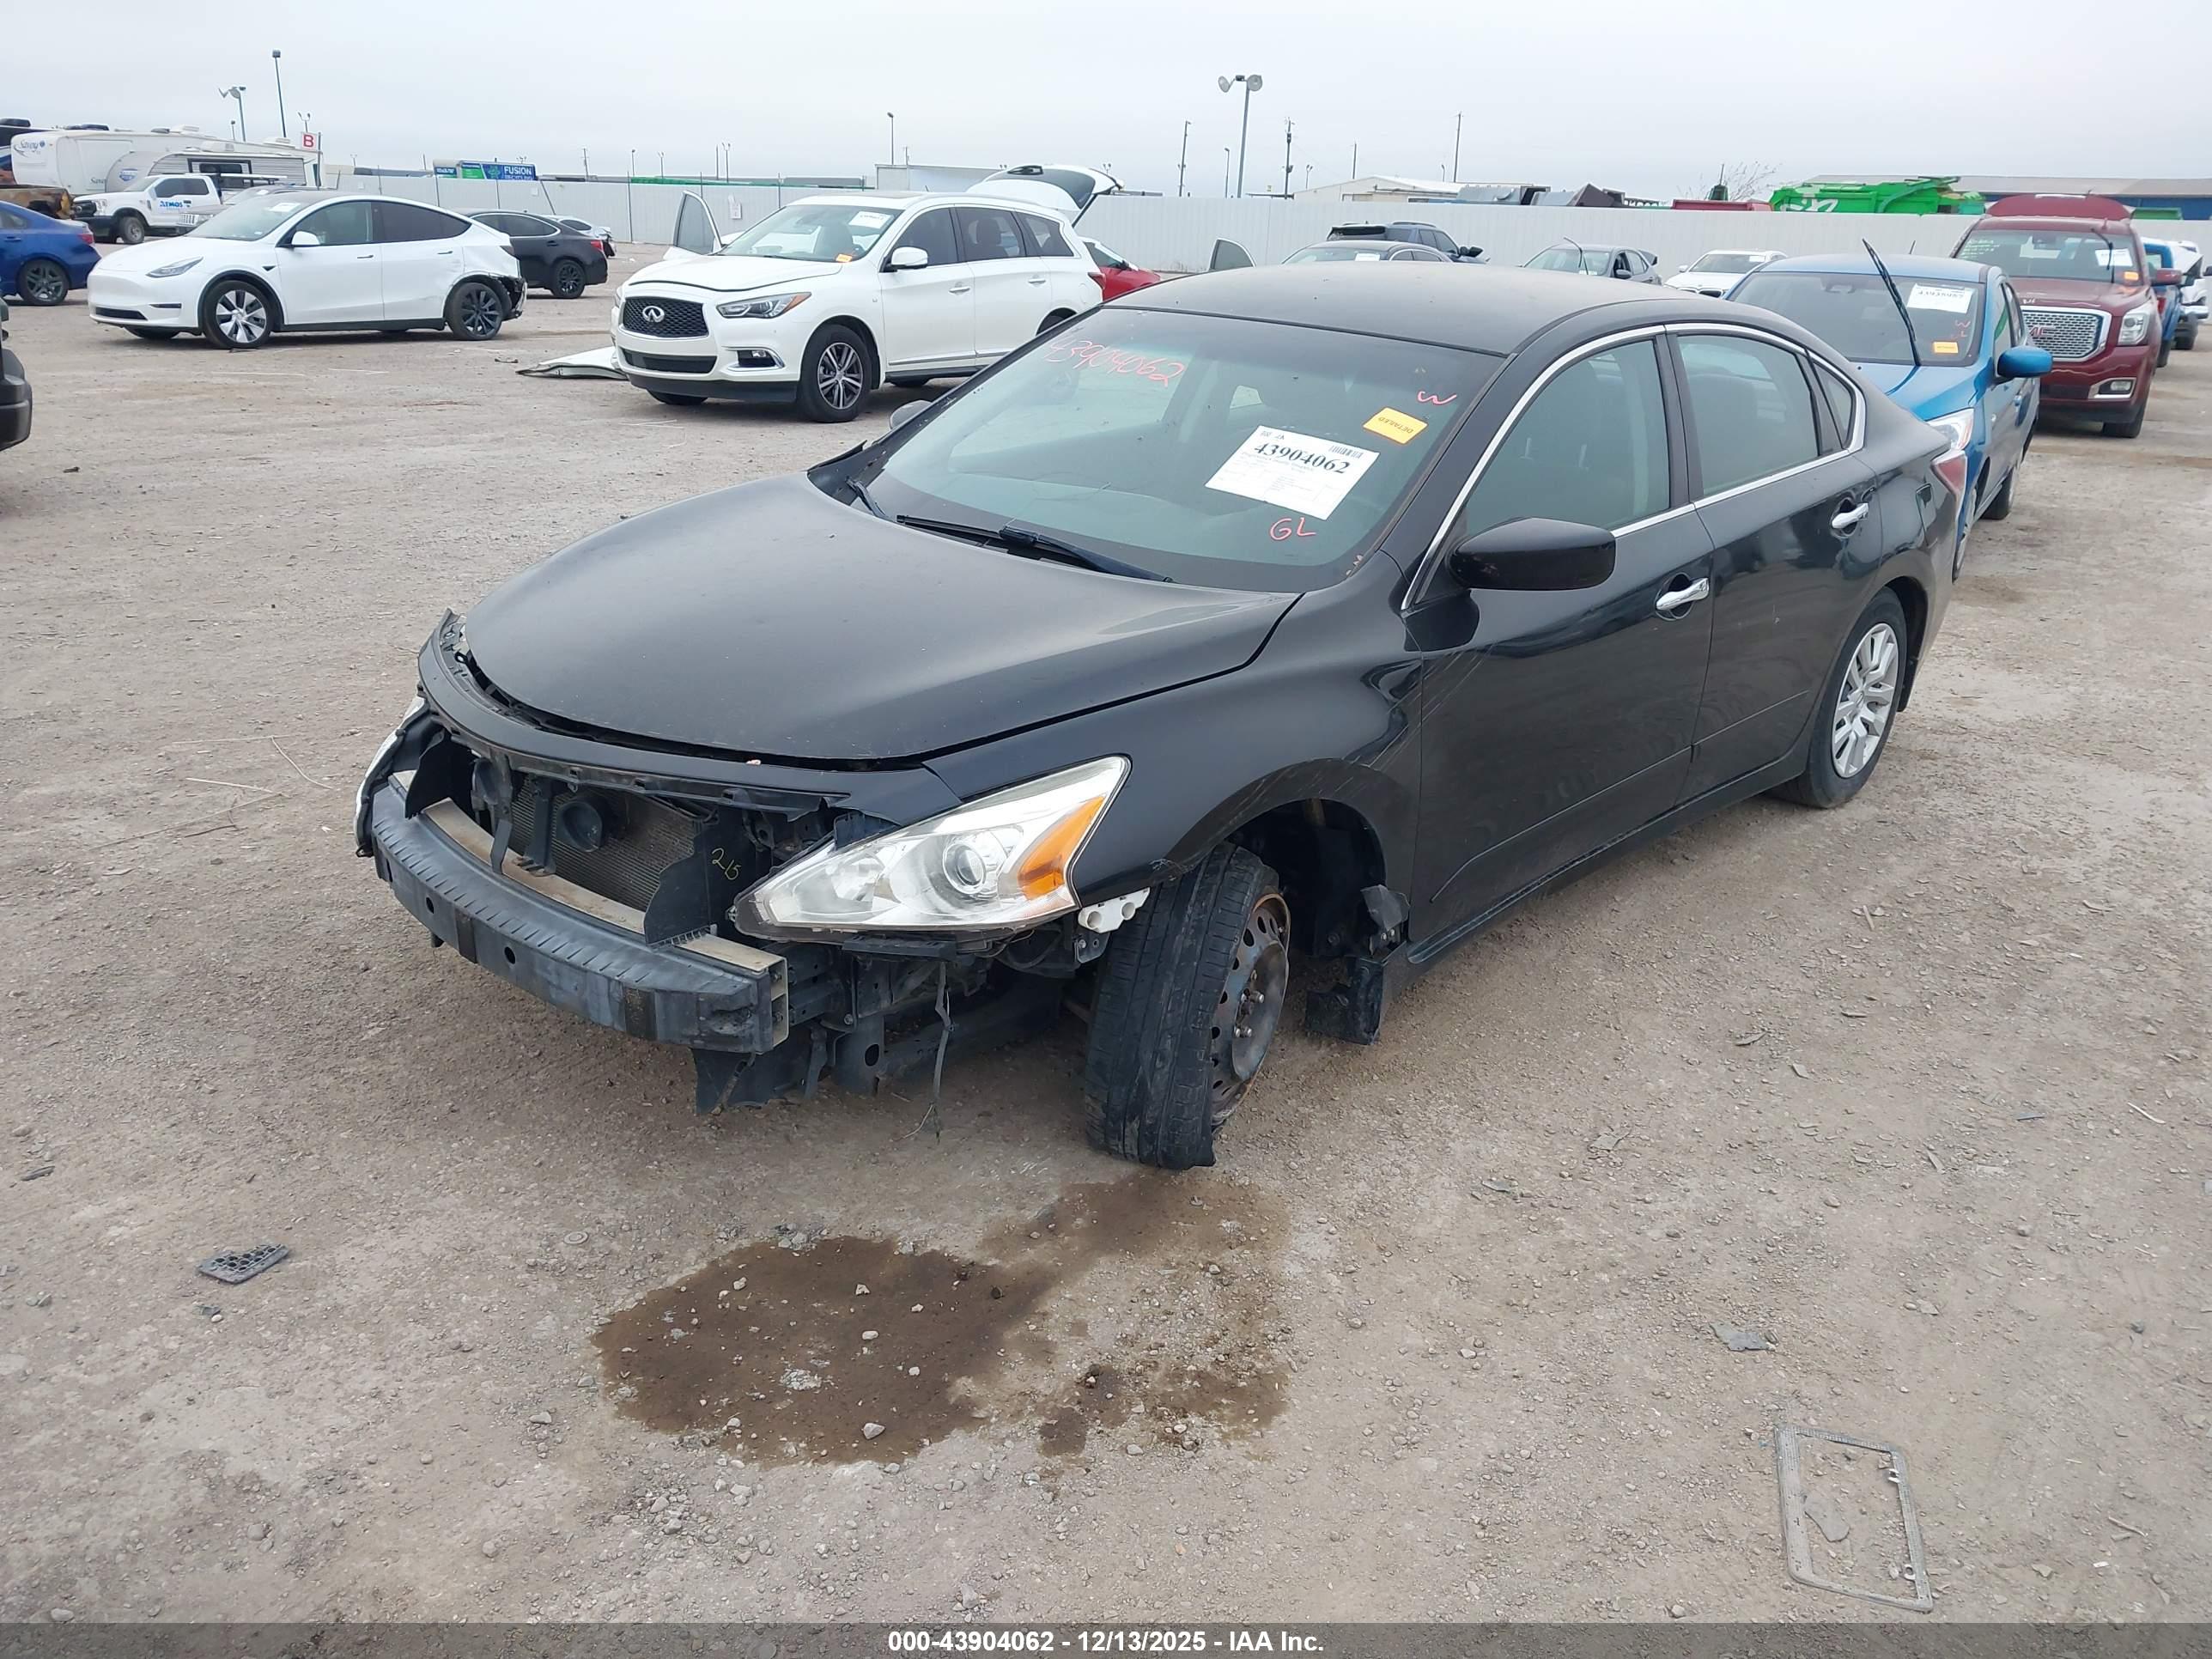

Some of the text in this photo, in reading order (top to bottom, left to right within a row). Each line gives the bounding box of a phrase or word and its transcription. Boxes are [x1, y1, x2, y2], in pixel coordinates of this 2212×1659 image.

[303, 134, 314, 148] B
[504, 166, 532, 175] FUSION
[1378, 416, 1414, 434] DETAILED
[1254, 442, 1351, 474] 43904062
